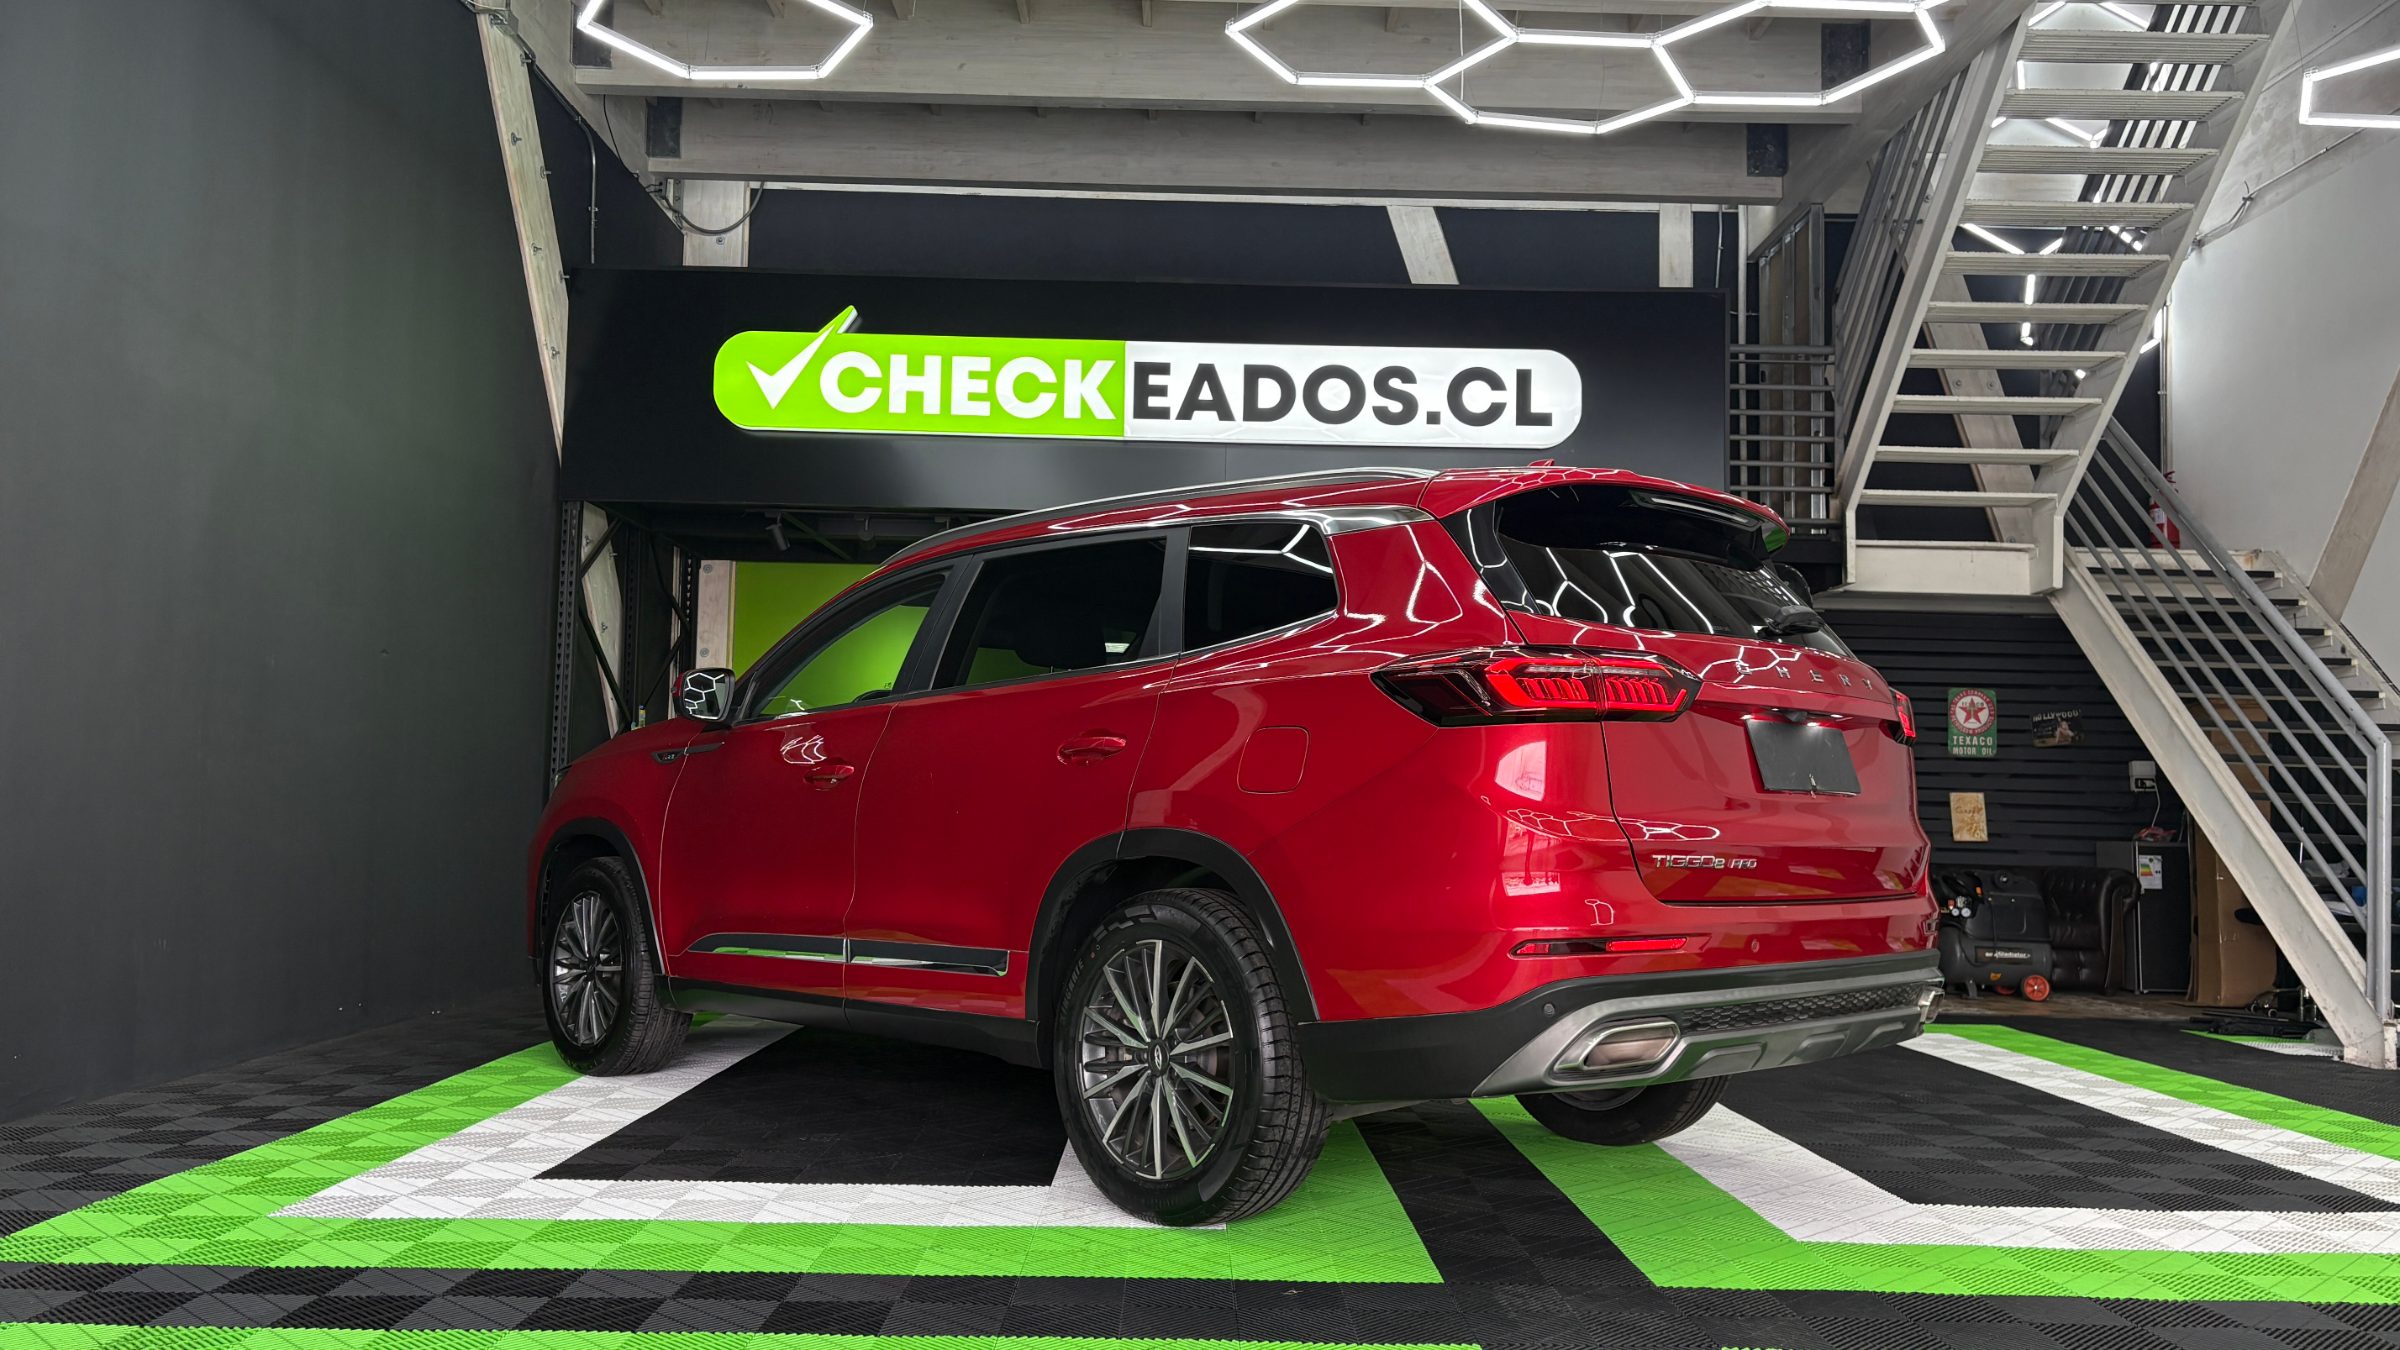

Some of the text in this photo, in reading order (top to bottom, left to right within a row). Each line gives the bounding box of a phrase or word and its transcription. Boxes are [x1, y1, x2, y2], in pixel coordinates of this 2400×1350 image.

[819, 350, 1554, 428] CHECKEADOS.CL
[1735, 660, 1873, 690] CHERY
[1952, 735, 1993, 746] TEXACO
[1952, 747, 1993, 755] MOTOR OIL
